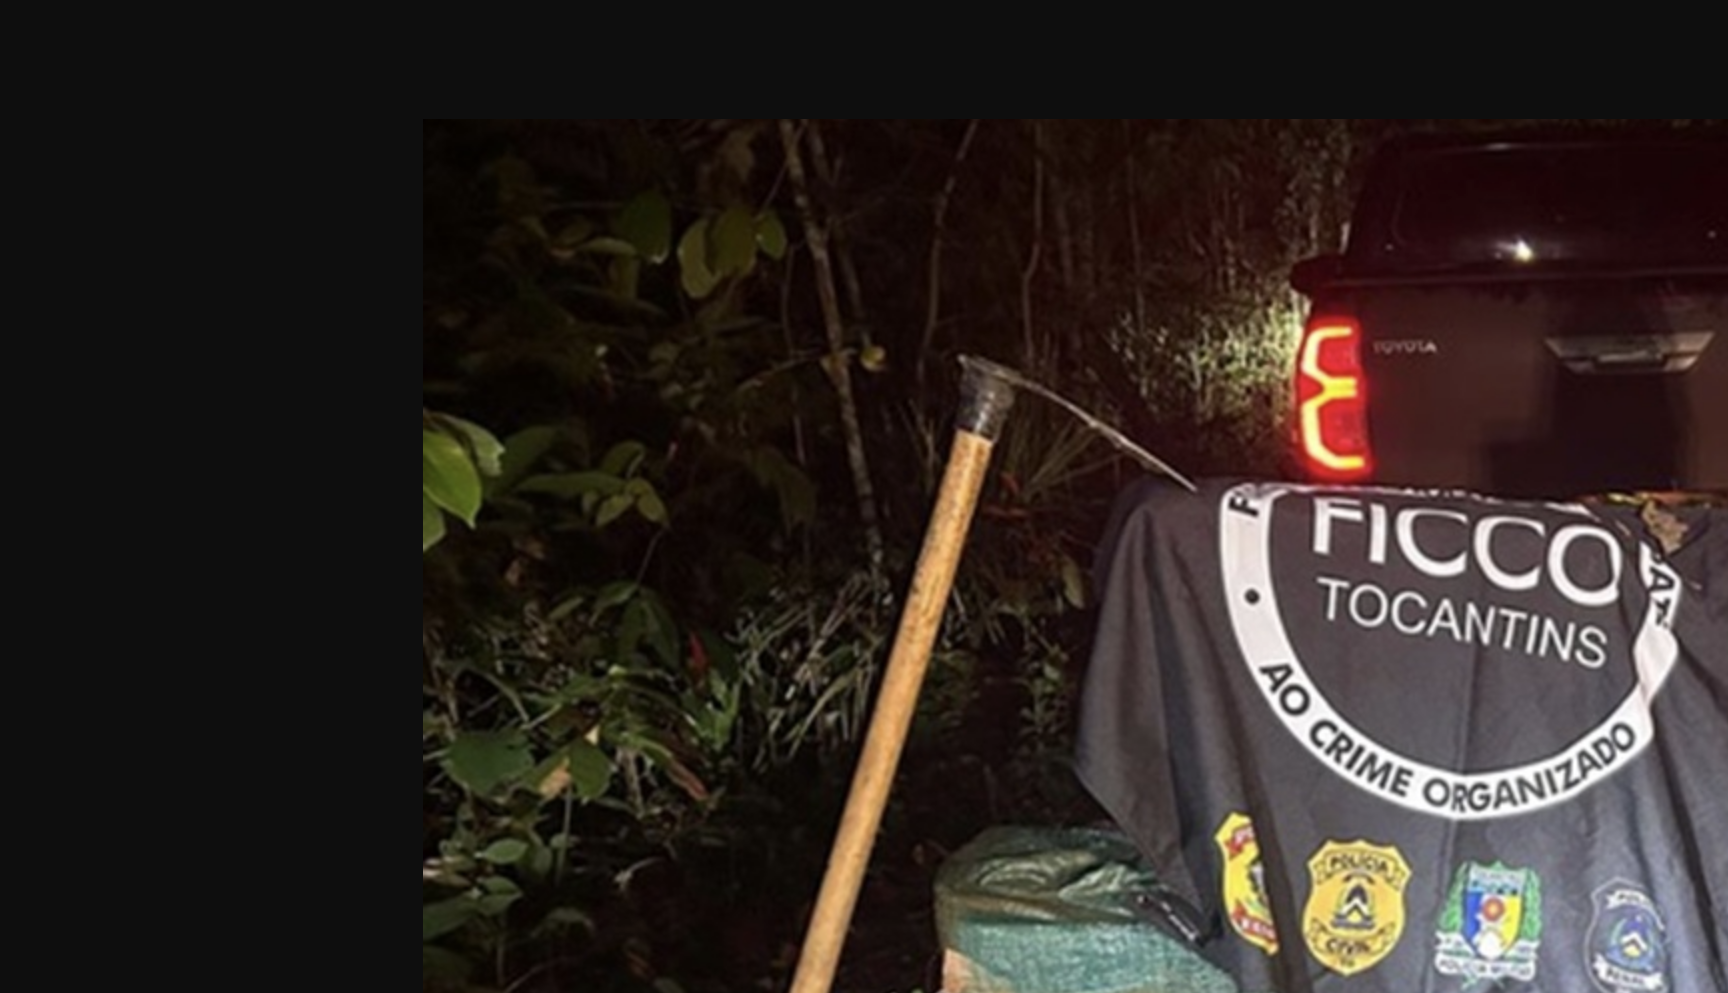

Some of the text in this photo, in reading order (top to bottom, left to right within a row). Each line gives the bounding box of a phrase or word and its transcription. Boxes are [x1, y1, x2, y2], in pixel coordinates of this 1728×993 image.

[1373, 340, 1438, 355] TOYOTA
[1312, 496, 1623, 607] FICCO
[1316, 576, 1608, 669] TOCANTINS
[1259, 662, 1637, 813] AO CRIME ORGANIZADO
